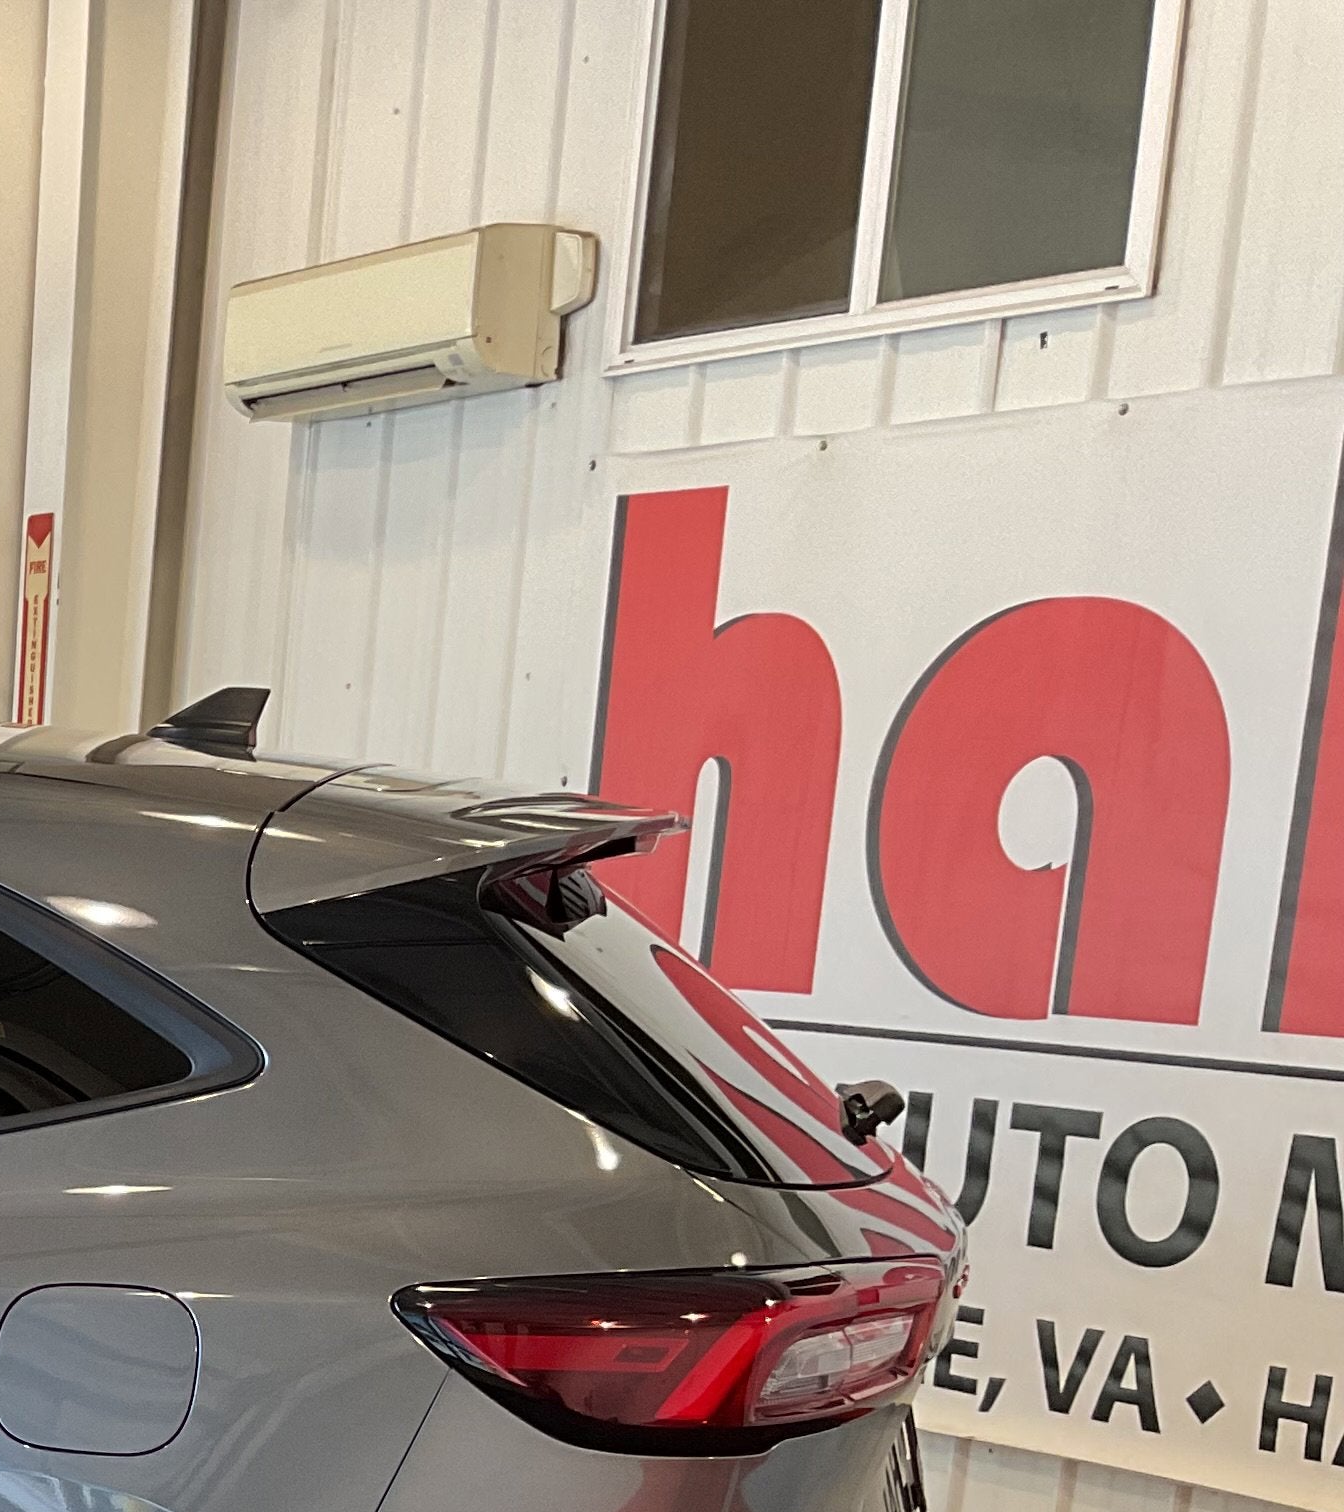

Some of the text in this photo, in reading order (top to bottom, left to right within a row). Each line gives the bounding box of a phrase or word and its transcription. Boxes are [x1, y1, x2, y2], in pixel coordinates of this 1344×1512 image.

[28, 560, 47, 575] FIRE
[836, 1084, 1220, 1268] UTO
[1036, 1319, 1161, 1434] VA
